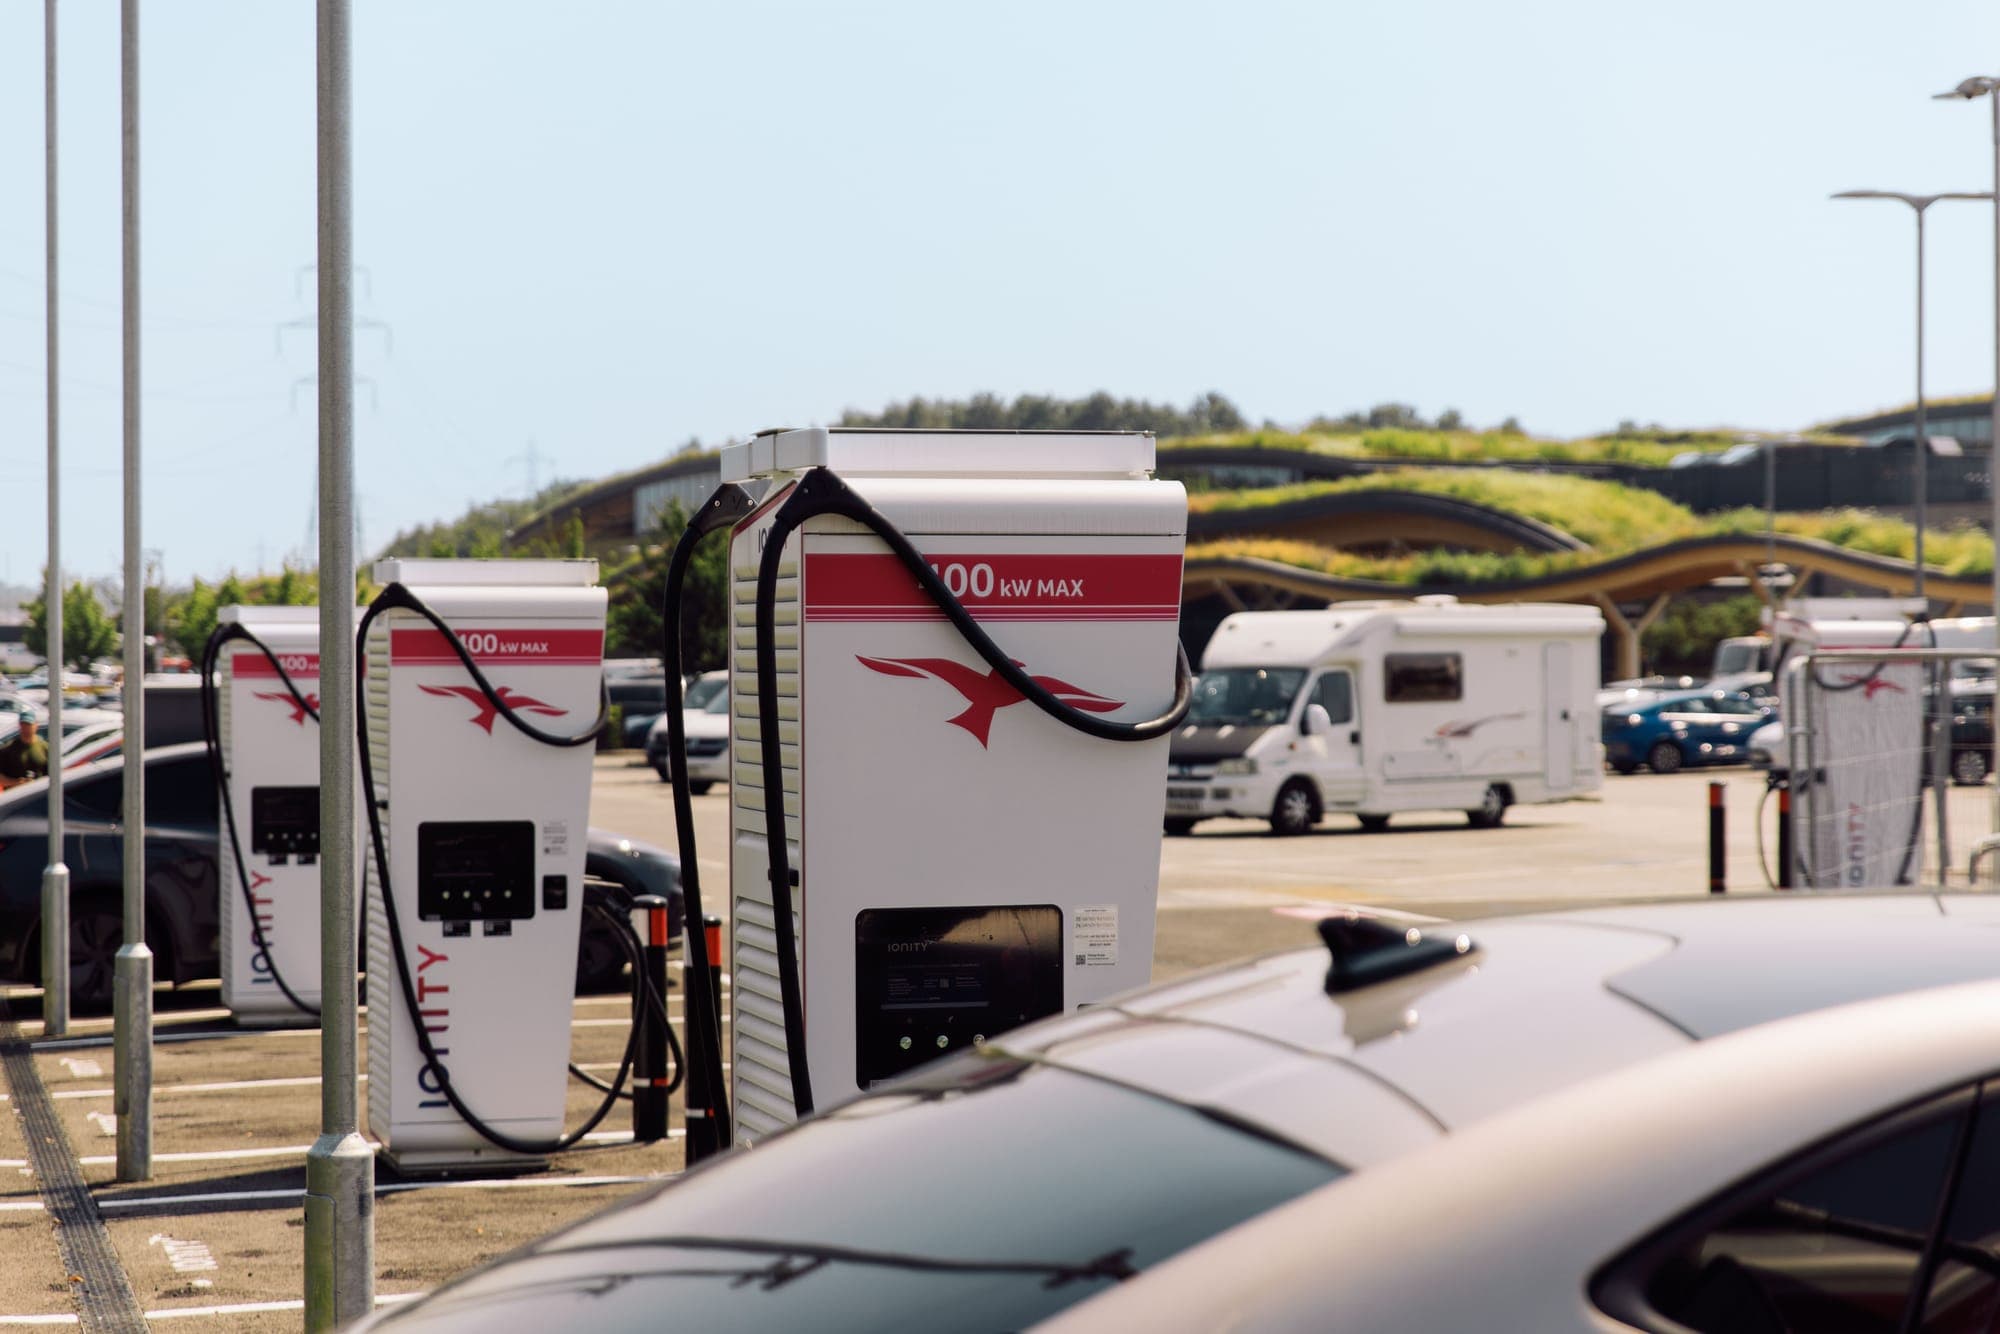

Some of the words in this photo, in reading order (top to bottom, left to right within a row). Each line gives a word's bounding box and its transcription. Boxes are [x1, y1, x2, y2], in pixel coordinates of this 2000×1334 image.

[919, 563, 994, 598] 00
[1000, 579, 1031, 597] kW
[1037, 579, 1084, 597] MAX
[500, 643, 519, 653] kW
[521, 643, 548, 653] MAX
